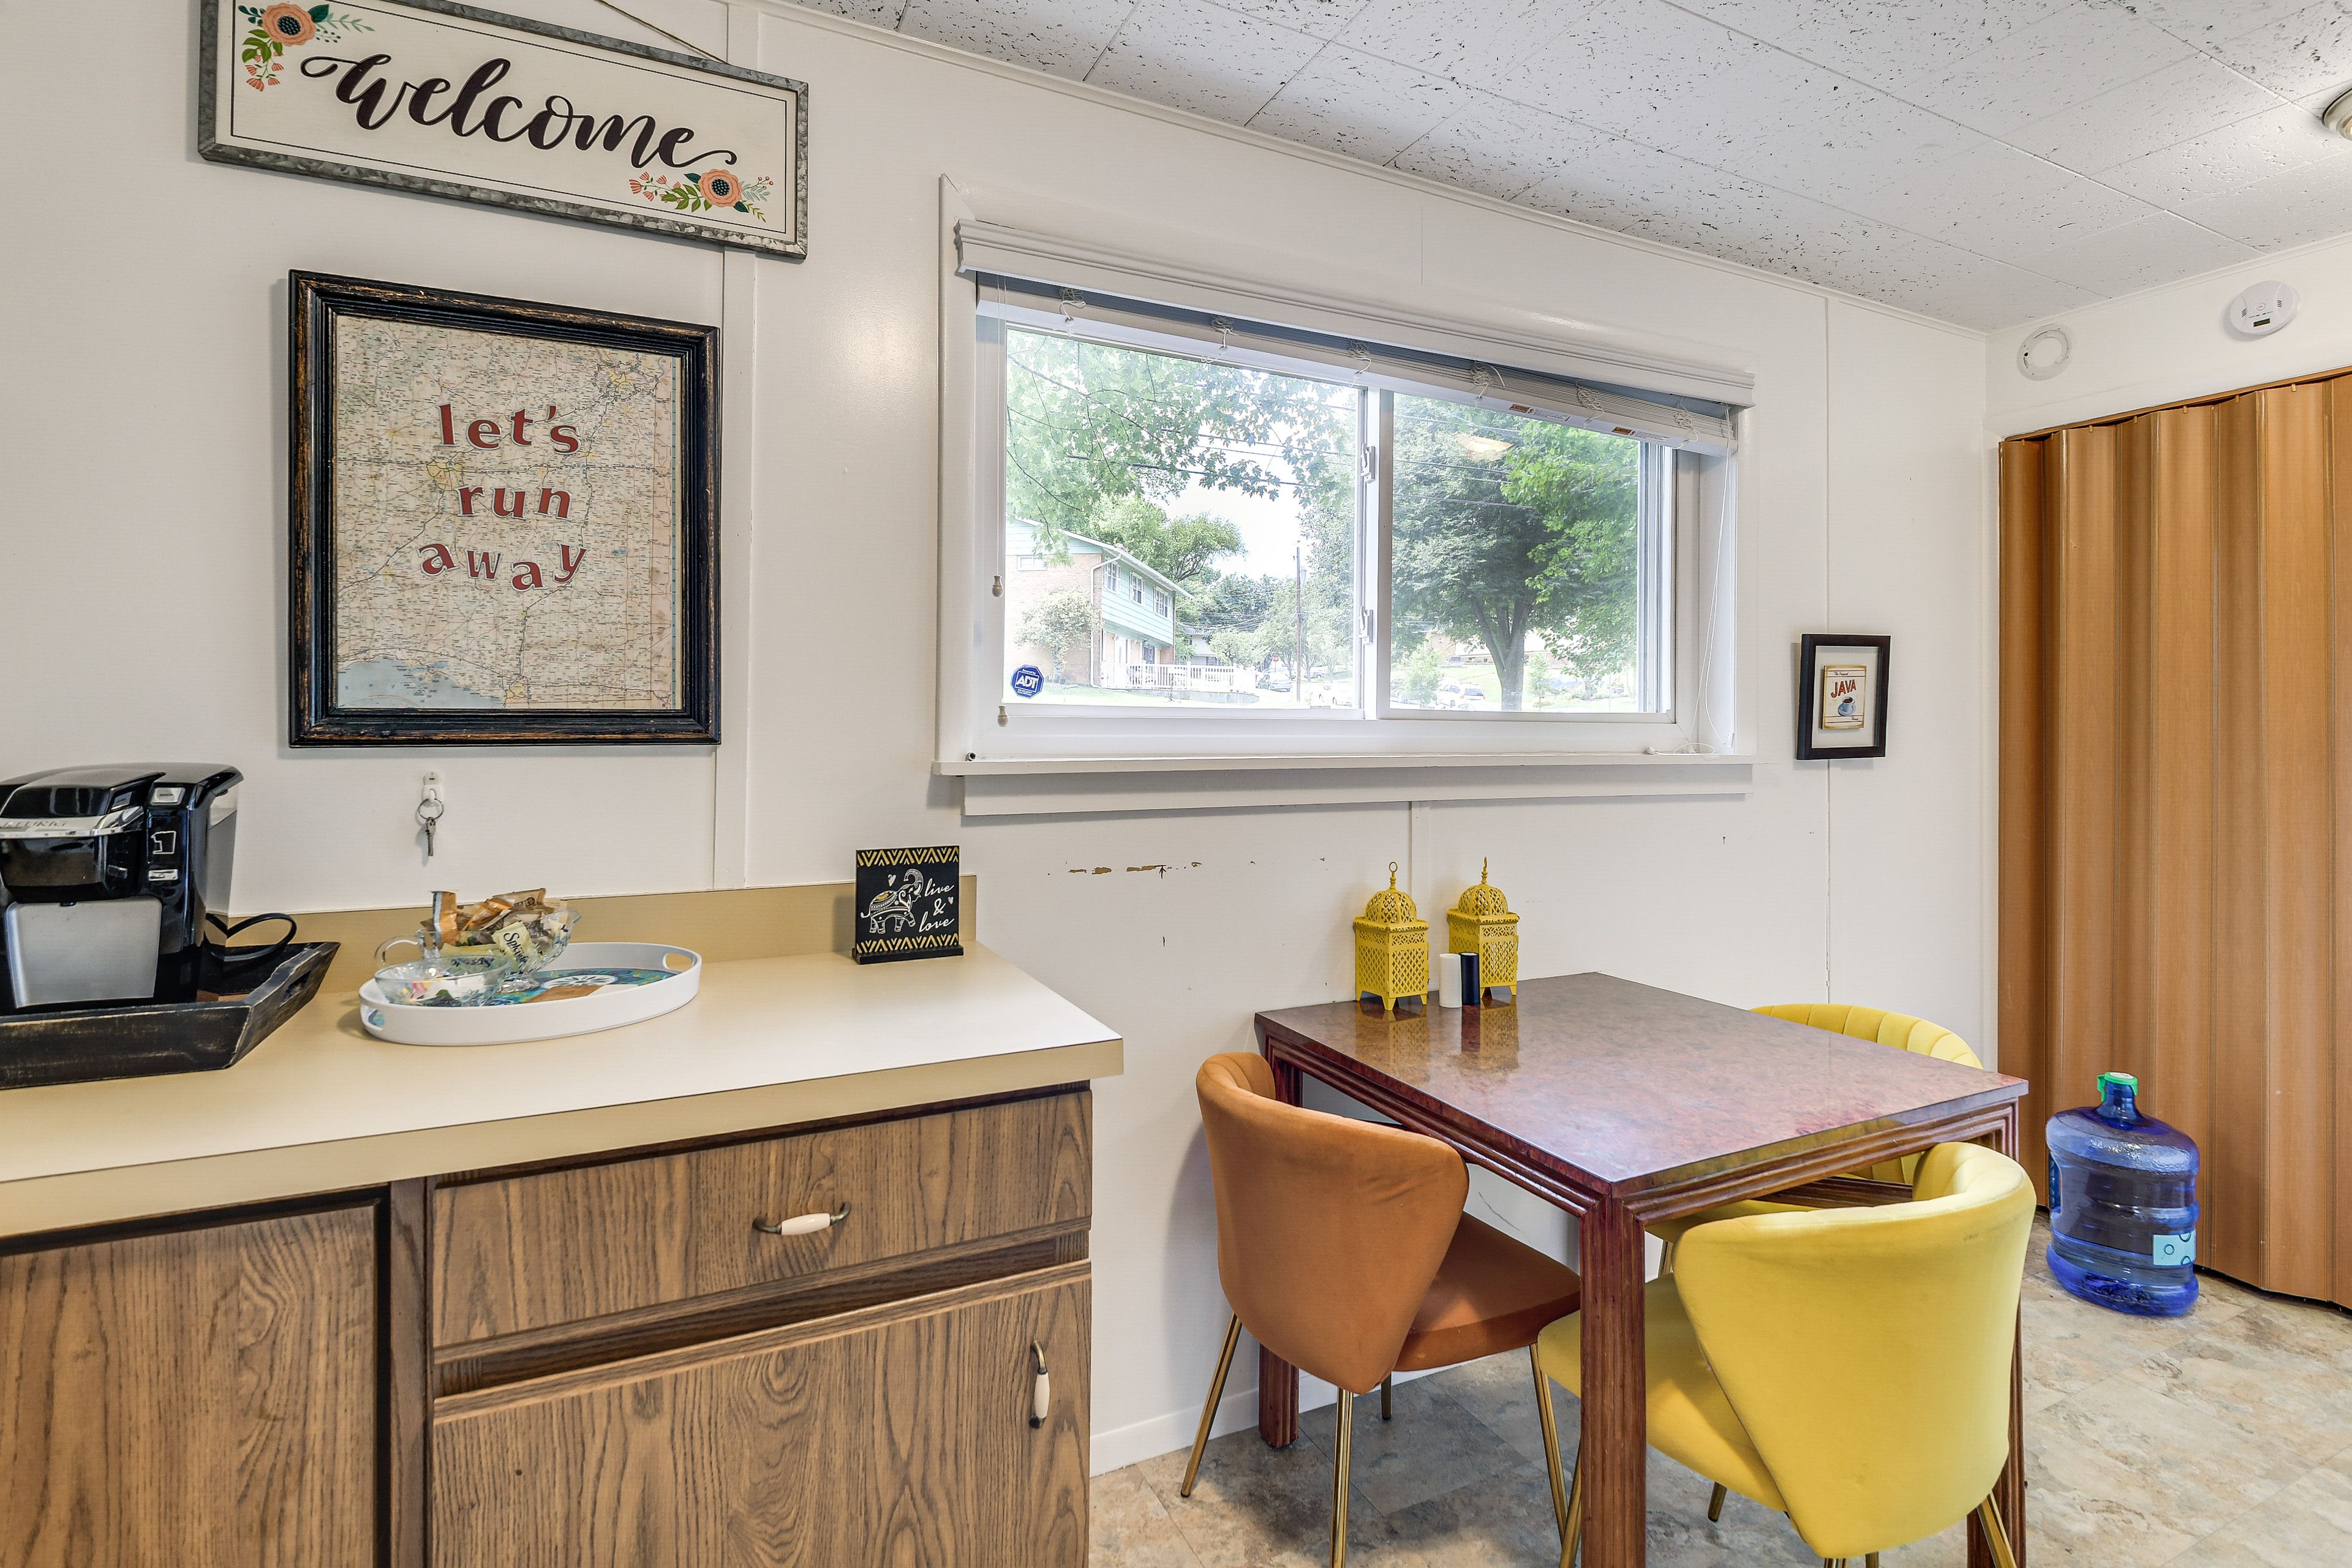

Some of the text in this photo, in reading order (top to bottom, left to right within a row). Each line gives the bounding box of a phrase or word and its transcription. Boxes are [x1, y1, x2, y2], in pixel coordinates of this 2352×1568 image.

[301, 53, 737, 170] welcome
[436, 404, 581, 454] let's
[457, 484, 573, 519] run
[418, 541, 589, 592] away
[1016, 675, 1039, 689] ADT
[1830, 679, 1856, 698] JAVA
[924, 878, 954, 897] live
[933, 898, 946, 916] &
[918, 911, 955, 933] love
